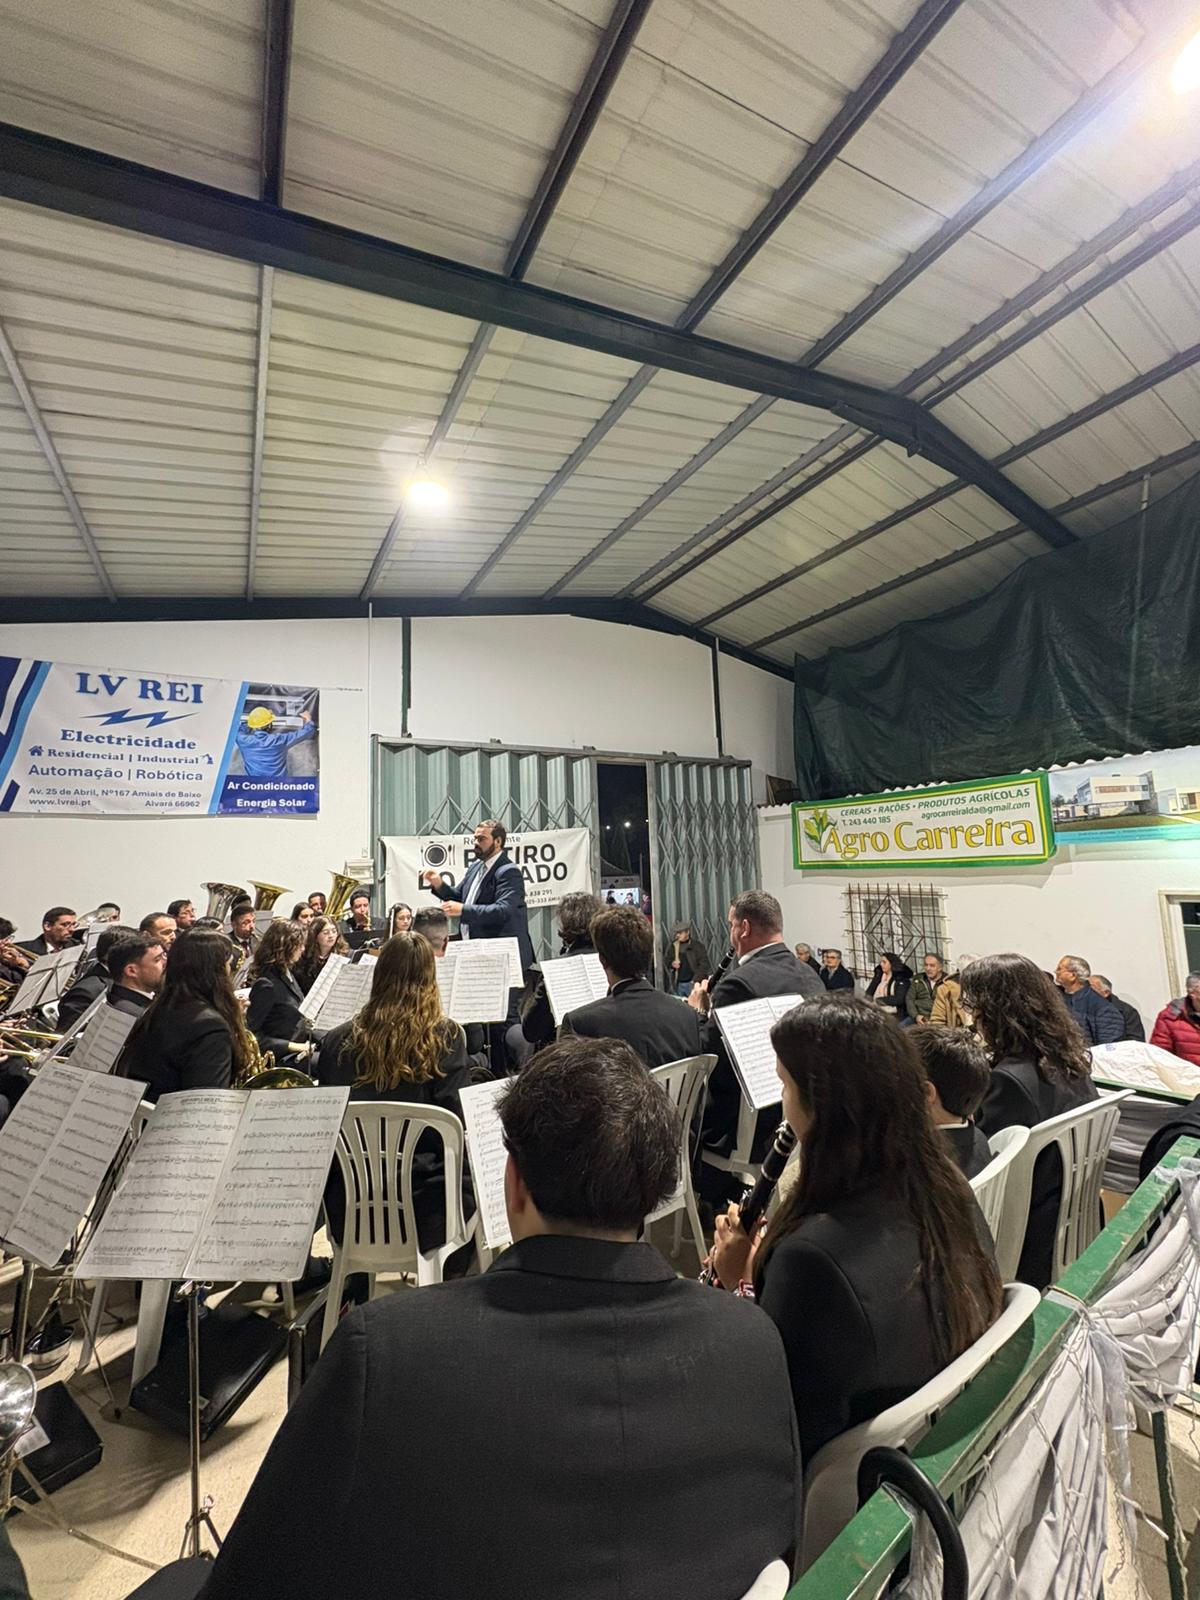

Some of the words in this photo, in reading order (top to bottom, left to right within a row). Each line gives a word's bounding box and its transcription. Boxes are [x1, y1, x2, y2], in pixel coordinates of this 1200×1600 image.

[76, 672, 127, 696] LV
[138, 679, 203, 704] REI
[61, 729, 197, 749] Electricidade
[48, 749, 124, 761] Residencial
[138, 754, 199, 764] Industrial
[29, 764, 123, 780] Automação
[136, 768, 203, 781] Robótica
[227, 782, 240, 790] Ar
[242, 782, 315, 790] Condicionado
[29, 788, 44, 796] Av.
[46, 788, 58, 796] 25
[59, 788, 72, 797] de
[74, 788, 99, 798] Abril,
[132, 790, 164, 798] Amiais
[165, 790, 177, 798] de
[178, 791, 202, 799] Baixo
[29, 798, 92, 807] www.lvrei.pt
[145, 800, 173, 808] Alvará
[236, 798, 277, 808] Energia
[279, 798, 307, 807] Solar
[840, 808, 872, 817] CEREAIS
[879, 802, 911, 815] RAÇÕES
[918, 795, 967, 810] PRODUTOS
[969, 787, 1030, 804] AGRÍCOLAS
[849, 818, 862, 826] 243
[863, 817, 877, 825] 440
[878, 816, 892, 824] 185
[822, 825, 889, 859] Agro
[894, 818, 1036, 852] Carreira
